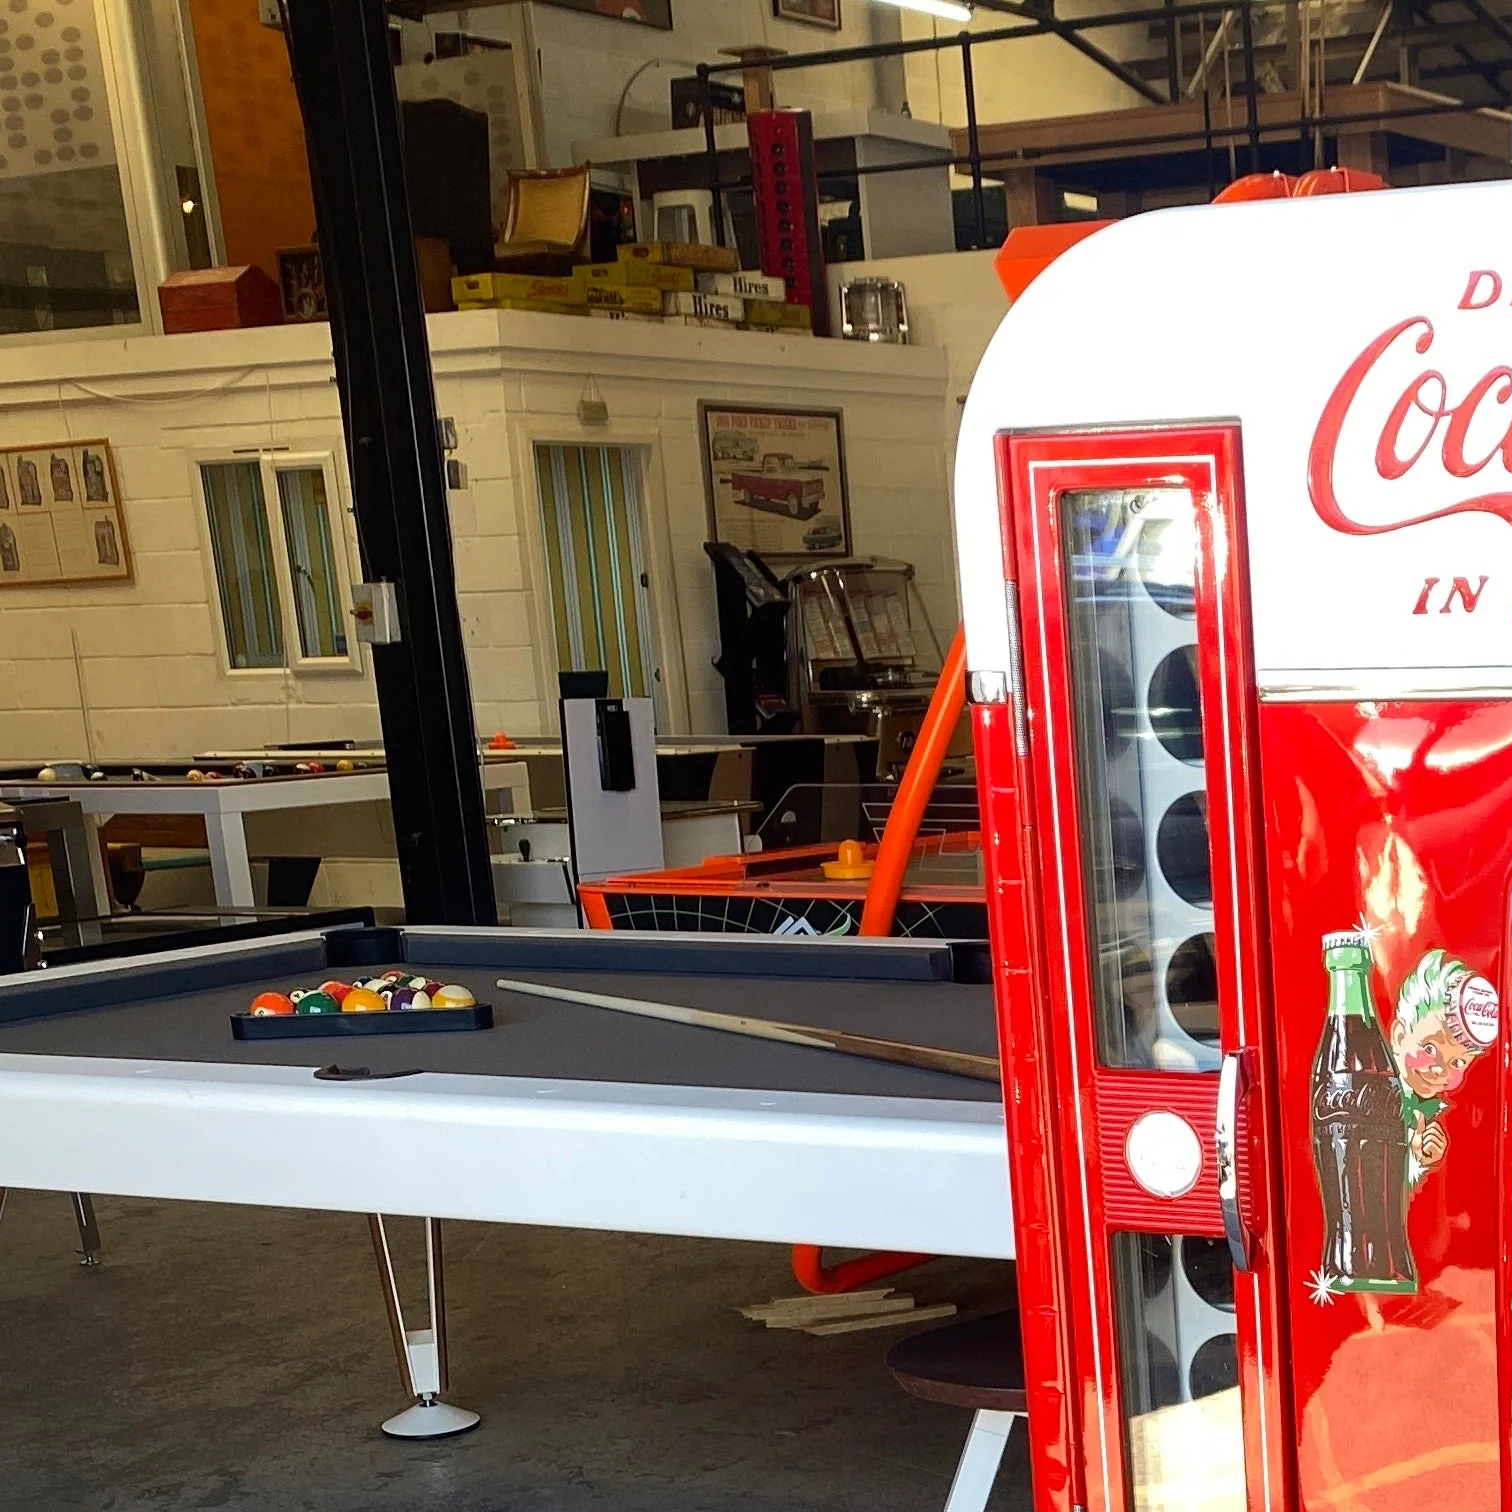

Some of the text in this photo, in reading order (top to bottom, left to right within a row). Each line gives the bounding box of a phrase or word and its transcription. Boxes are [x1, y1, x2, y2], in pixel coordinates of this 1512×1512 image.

[732, 275, 769, 295] Hires
[692, 295, 730, 319] Hires
[1412, 575, 1490, 616] IN
